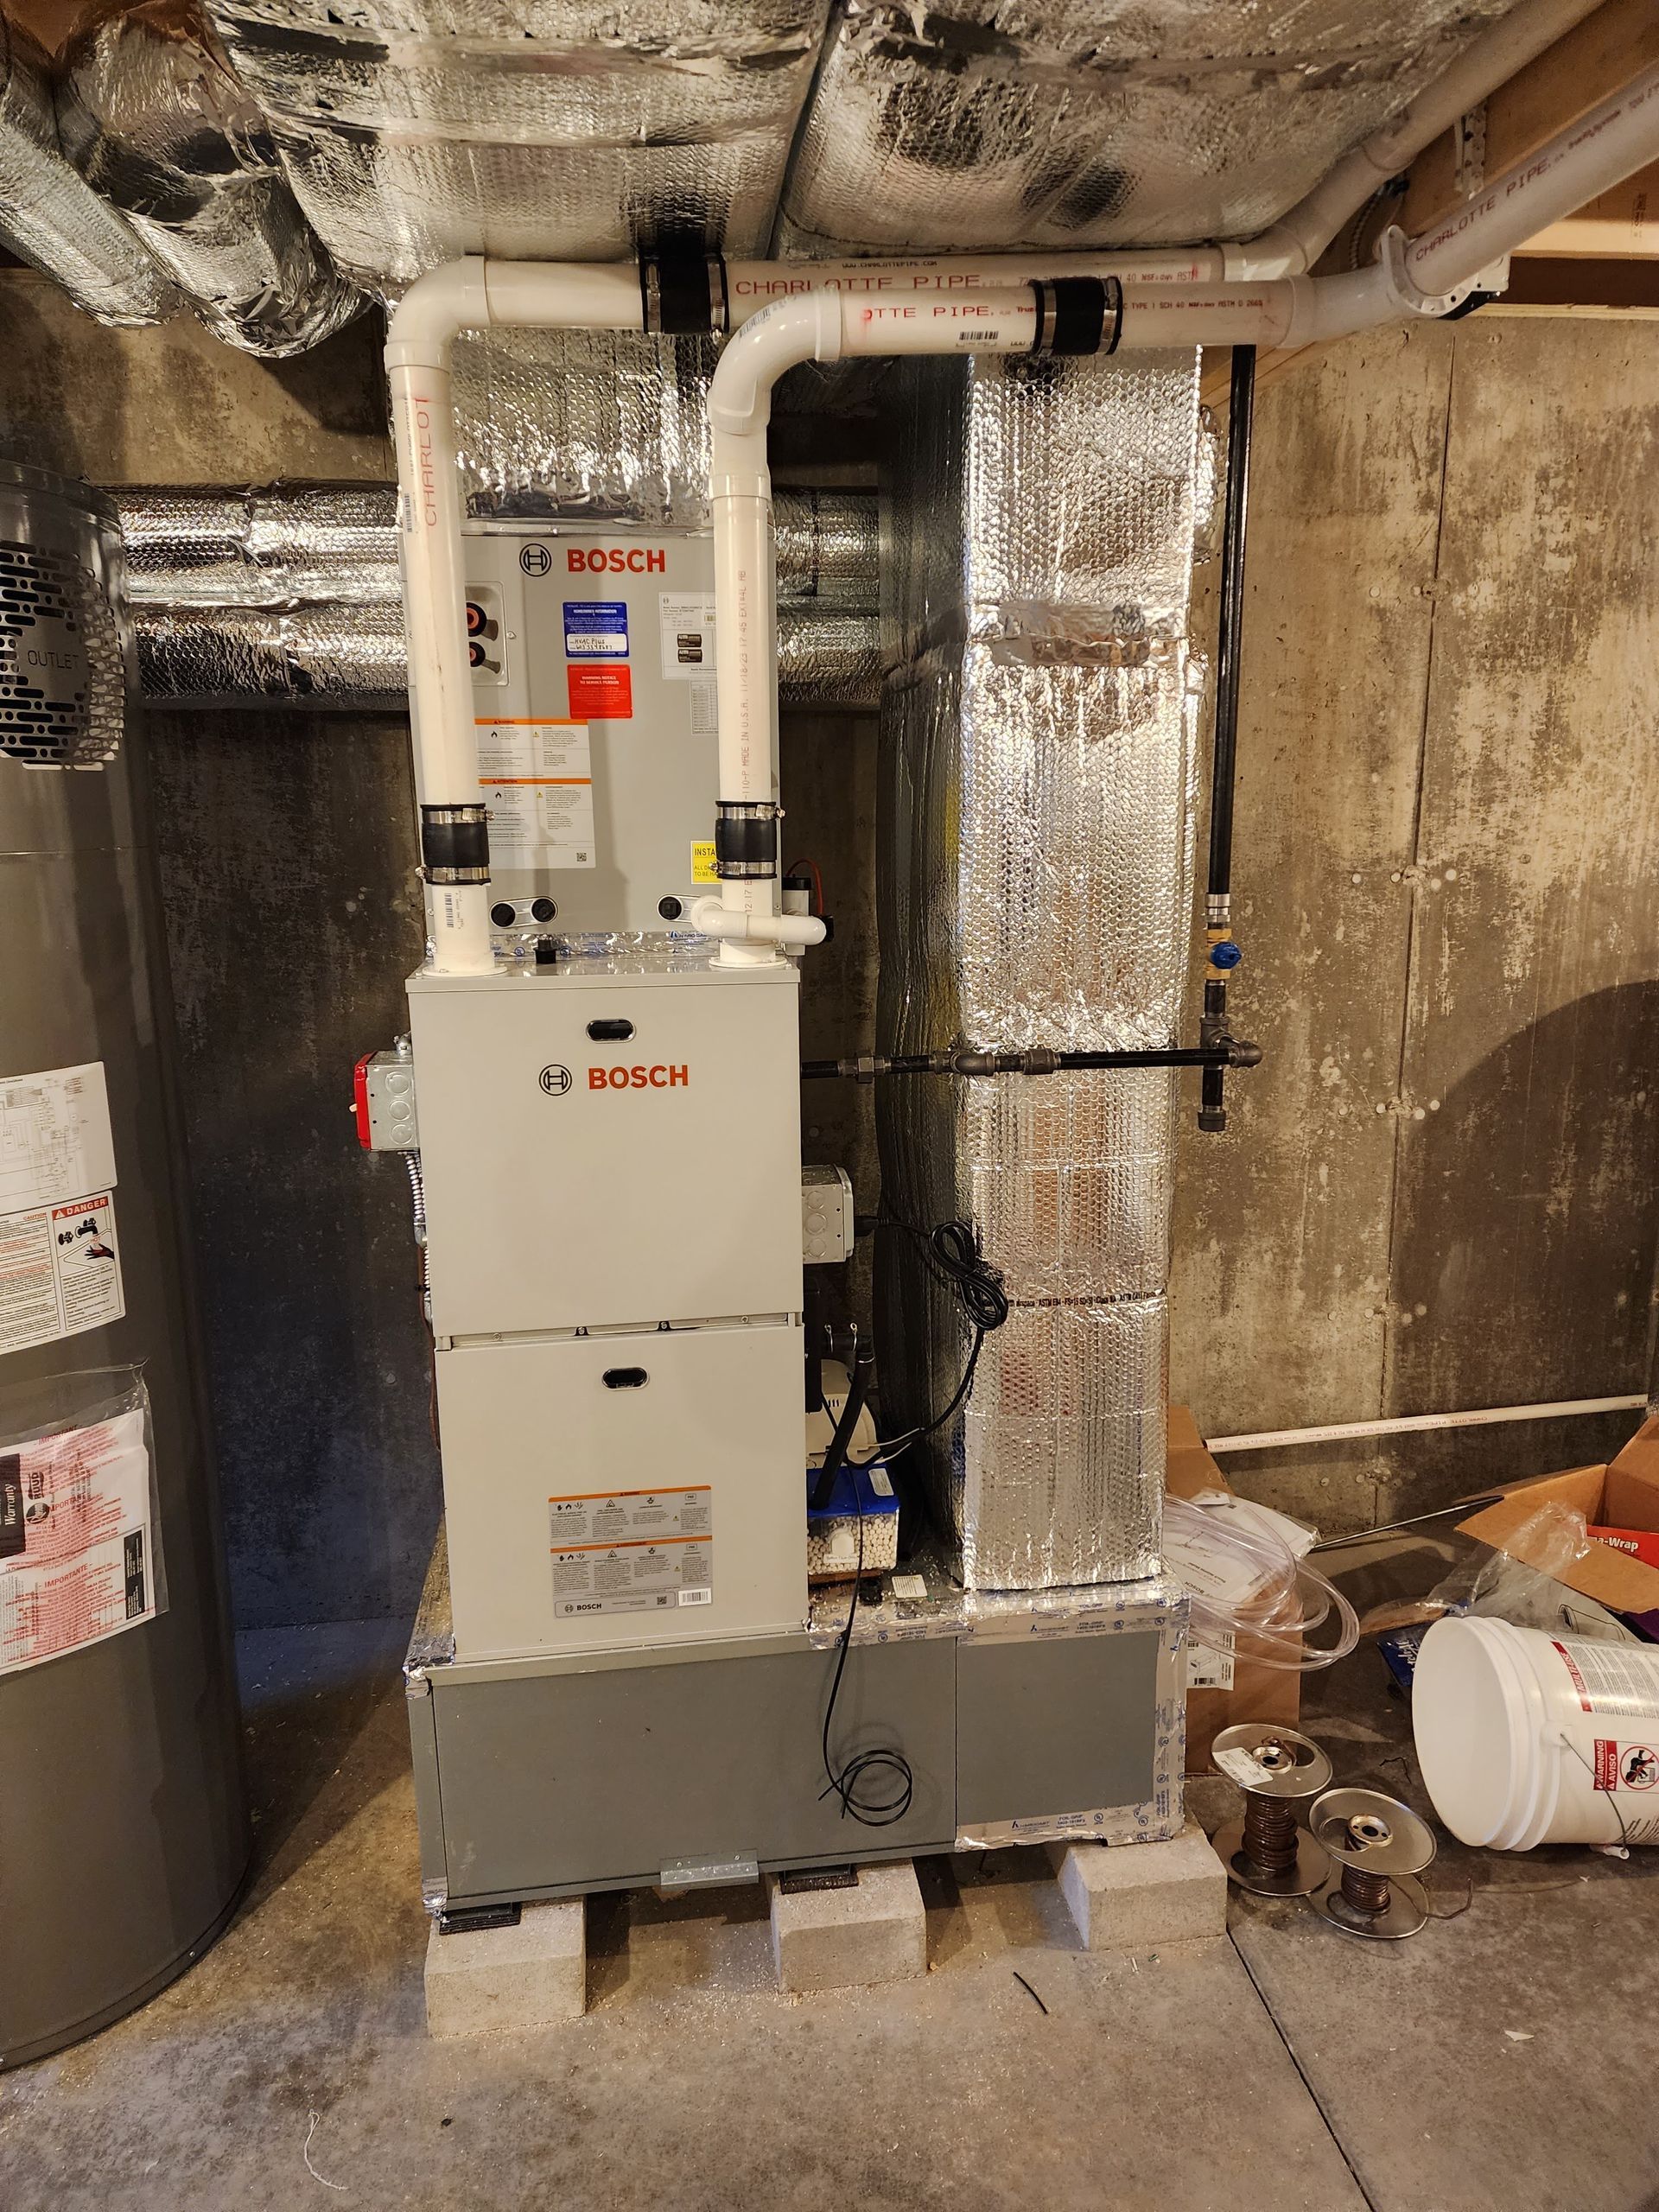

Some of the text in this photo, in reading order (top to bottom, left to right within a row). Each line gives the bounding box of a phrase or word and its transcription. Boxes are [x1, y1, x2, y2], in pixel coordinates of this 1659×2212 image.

[1416, 196, 1496, 262] CHARLOTTE
[567, 549, 666, 573] BOSCH
[28, 650, 79, 670] OUTLET
[588, 1064, 689, 1090] BOSCH
[67, 1198, 106, 1216] DANGER
[4, 1484, 16, 1526] Warranty
[1596, 1740, 1605, 1783] WARNING
[1608, 1753, 1617, 1783] AVISO
